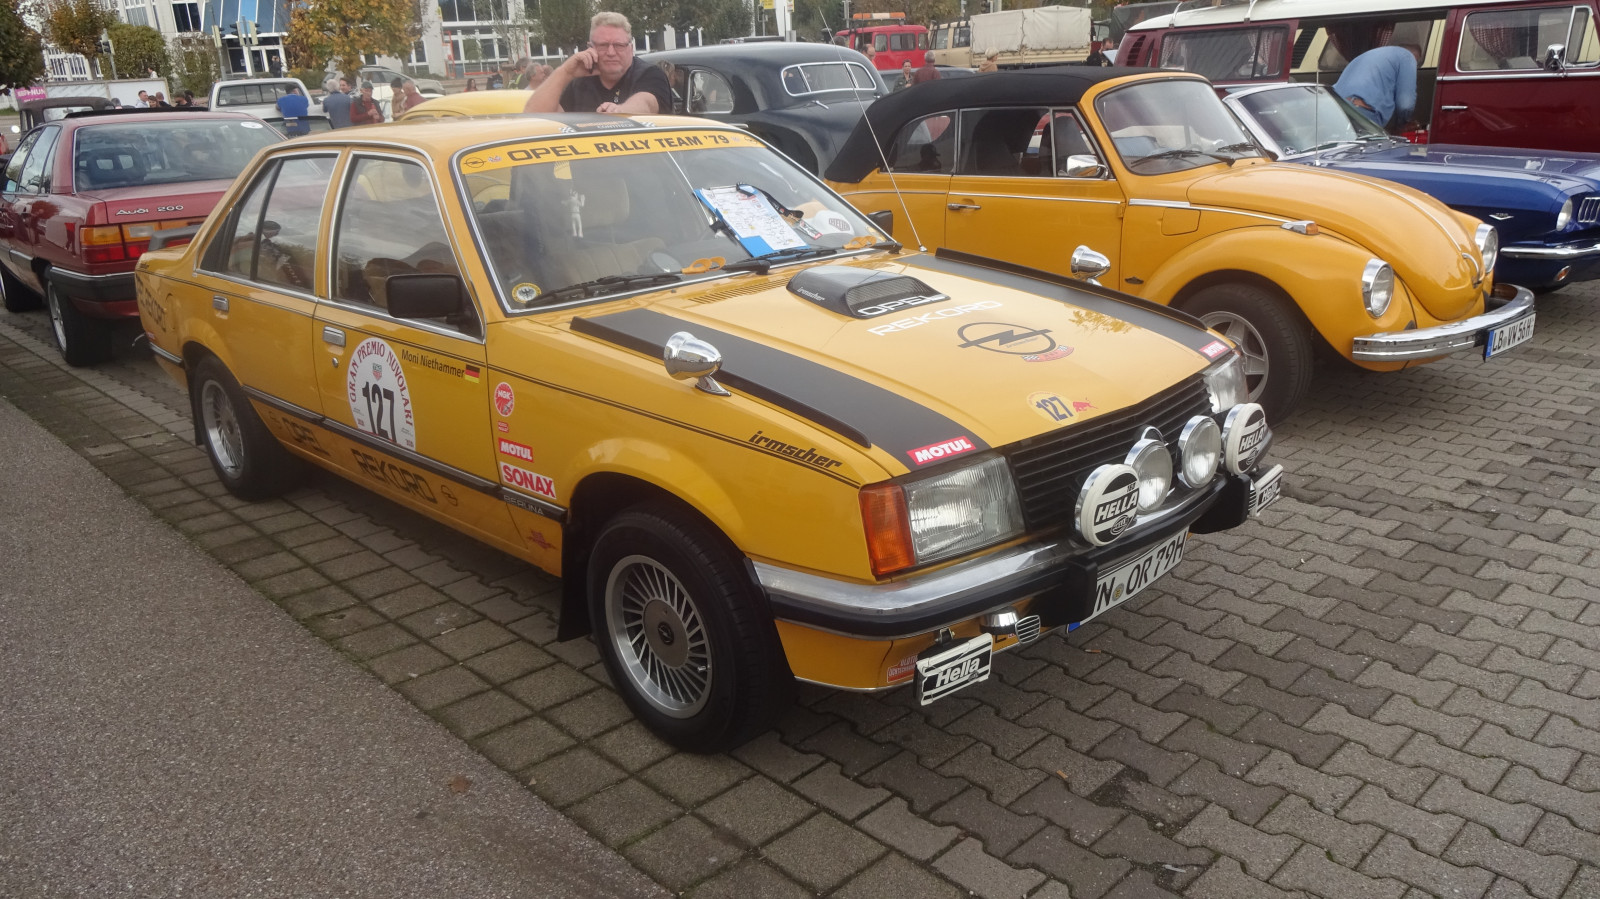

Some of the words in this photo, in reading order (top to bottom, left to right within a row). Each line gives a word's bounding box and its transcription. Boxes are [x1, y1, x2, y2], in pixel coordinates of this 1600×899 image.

[507, 144, 590, 162] OPEL
[594, 139, 651, 155] RALLY
[653, 136, 703, 150] TEAM
[703, 134, 729, 146] '79
[157, 204, 184, 213] 200
[857, 293, 949, 317] OPEL
[866, 300, 1003, 336] REKORD
[1492, 330, 1504, 352] LB
[1507, 324, 1519, 346] VW
[401, 349, 419, 365] Moni
[420, 354, 466, 379] Niethammer
[349, 360, 359, 403] GRAN
[357, 341, 385, 364] PREMIO
[386, 352, 413, 427] NUVOLARI
[497, 390, 512, 400] NGK
[362, 381, 397, 443] 127
[1036, 396, 1074, 421] 127
[500, 441, 533, 461] MOTUL
[748, 430, 844, 469] irmscher
[914, 439, 972, 463] MOTUL
[1239, 425, 1265, 452] HELLA
[351, 448, 438, 504] REKORD
[502, 465, 556, 498] SONAX
[503, 494, 544, 516] BERLINA
[1095, 490, 1139, 523] HELLA
[1126, 555, 1153, 596] OR
[1153, 531, 1187, 578] 79H
[935, 657, 981, 688] Hella
